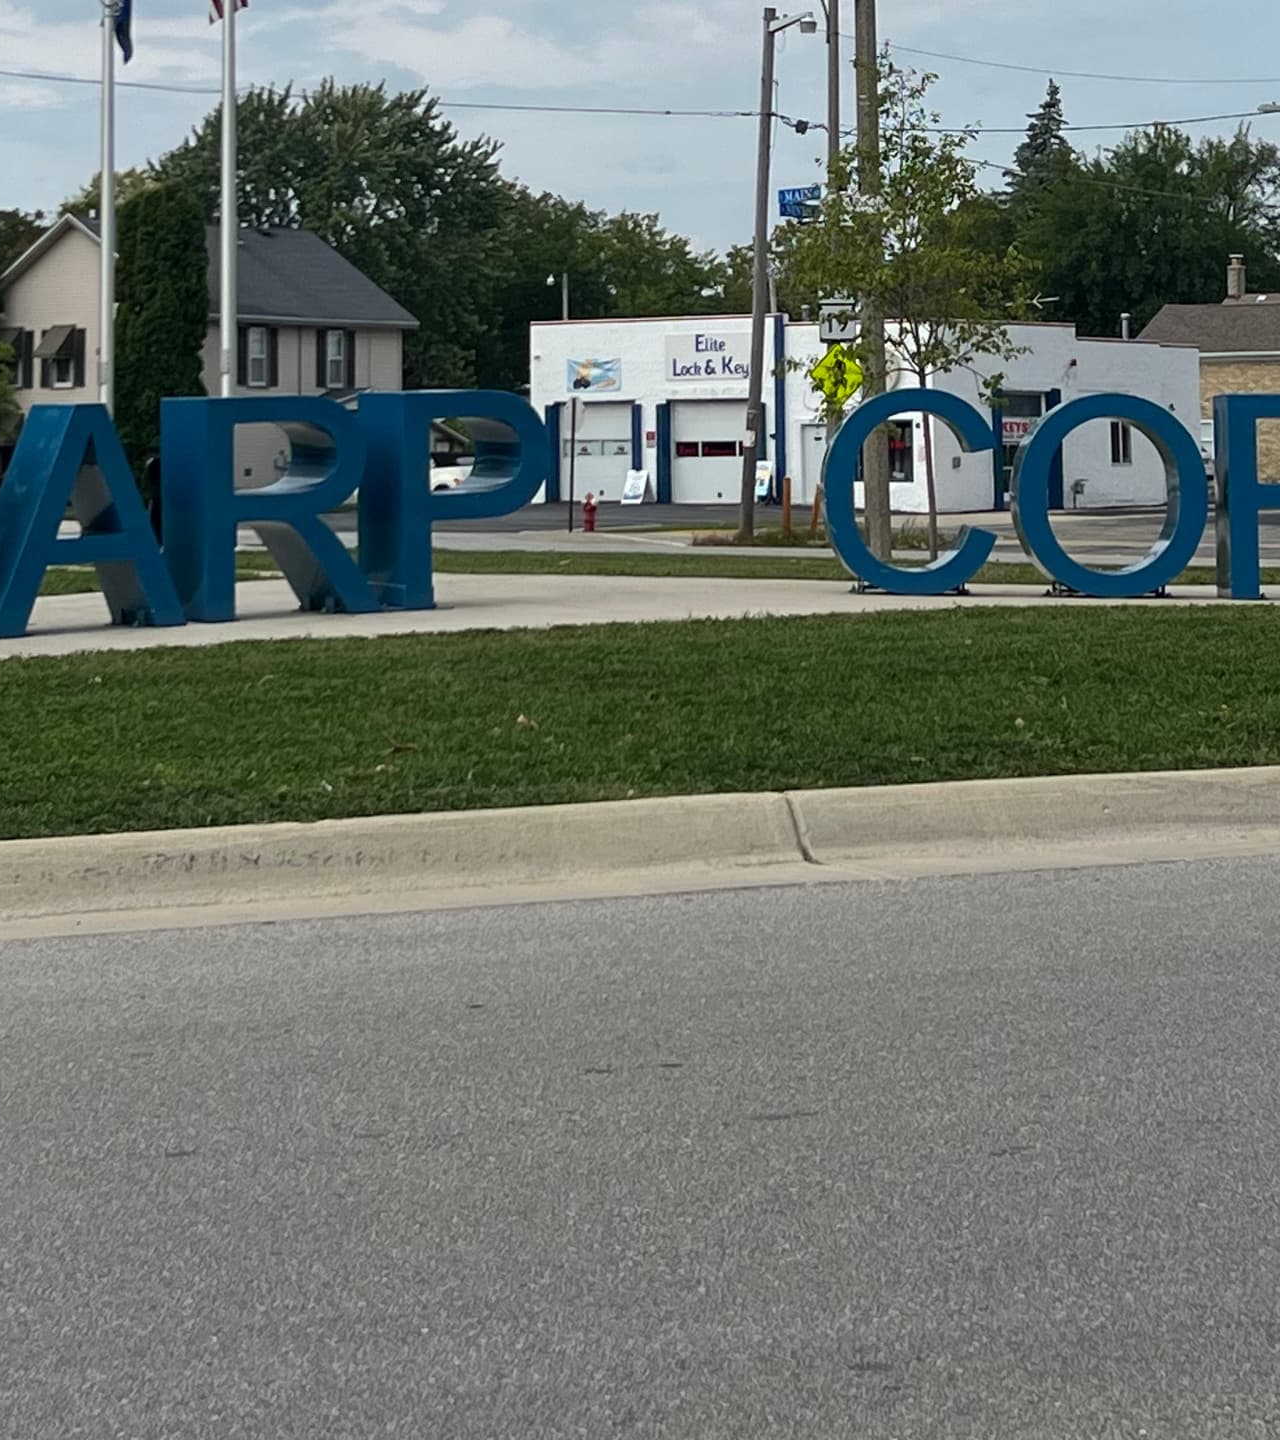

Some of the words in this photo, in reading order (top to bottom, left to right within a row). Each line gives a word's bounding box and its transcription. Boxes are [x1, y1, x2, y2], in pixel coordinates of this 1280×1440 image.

[695, 334, 726, 353] Elite
[673, 358, 702, 377] Lock
[705, 359, 716, 376] &
[721, 356, 750, 379] Key
